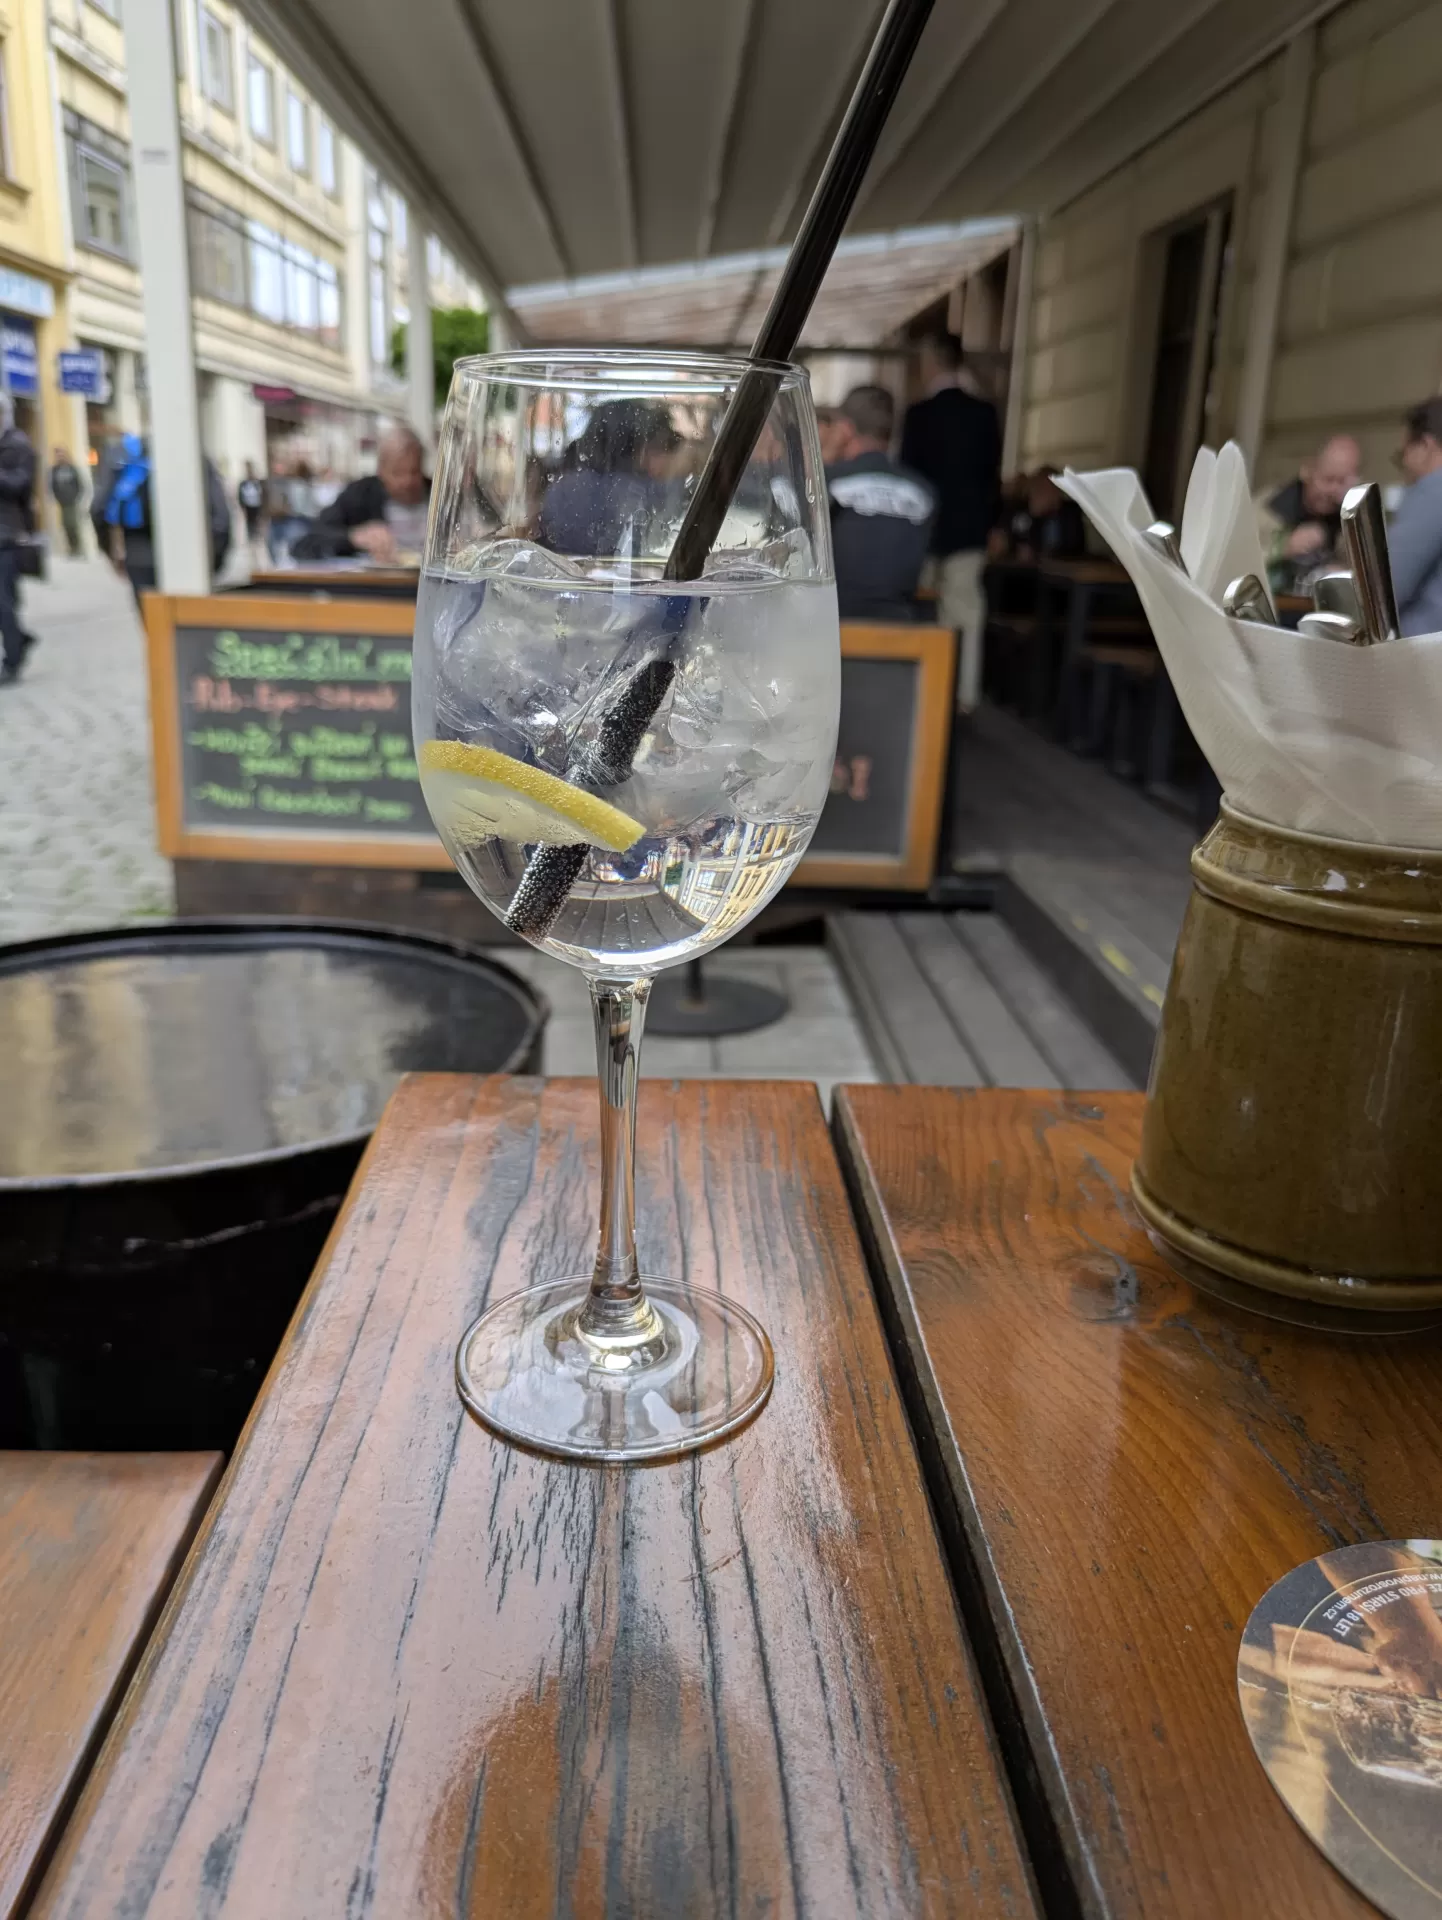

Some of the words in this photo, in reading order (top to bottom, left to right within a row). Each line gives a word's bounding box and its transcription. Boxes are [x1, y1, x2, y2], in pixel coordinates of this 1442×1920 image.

[1398, 1584, 1428, 1599] PRO
[1426, 1583, 1442, 1594] ZE
[1346, 1609, 1364, 1623] 18
[1332, 1617, 1351, 1637] LET
